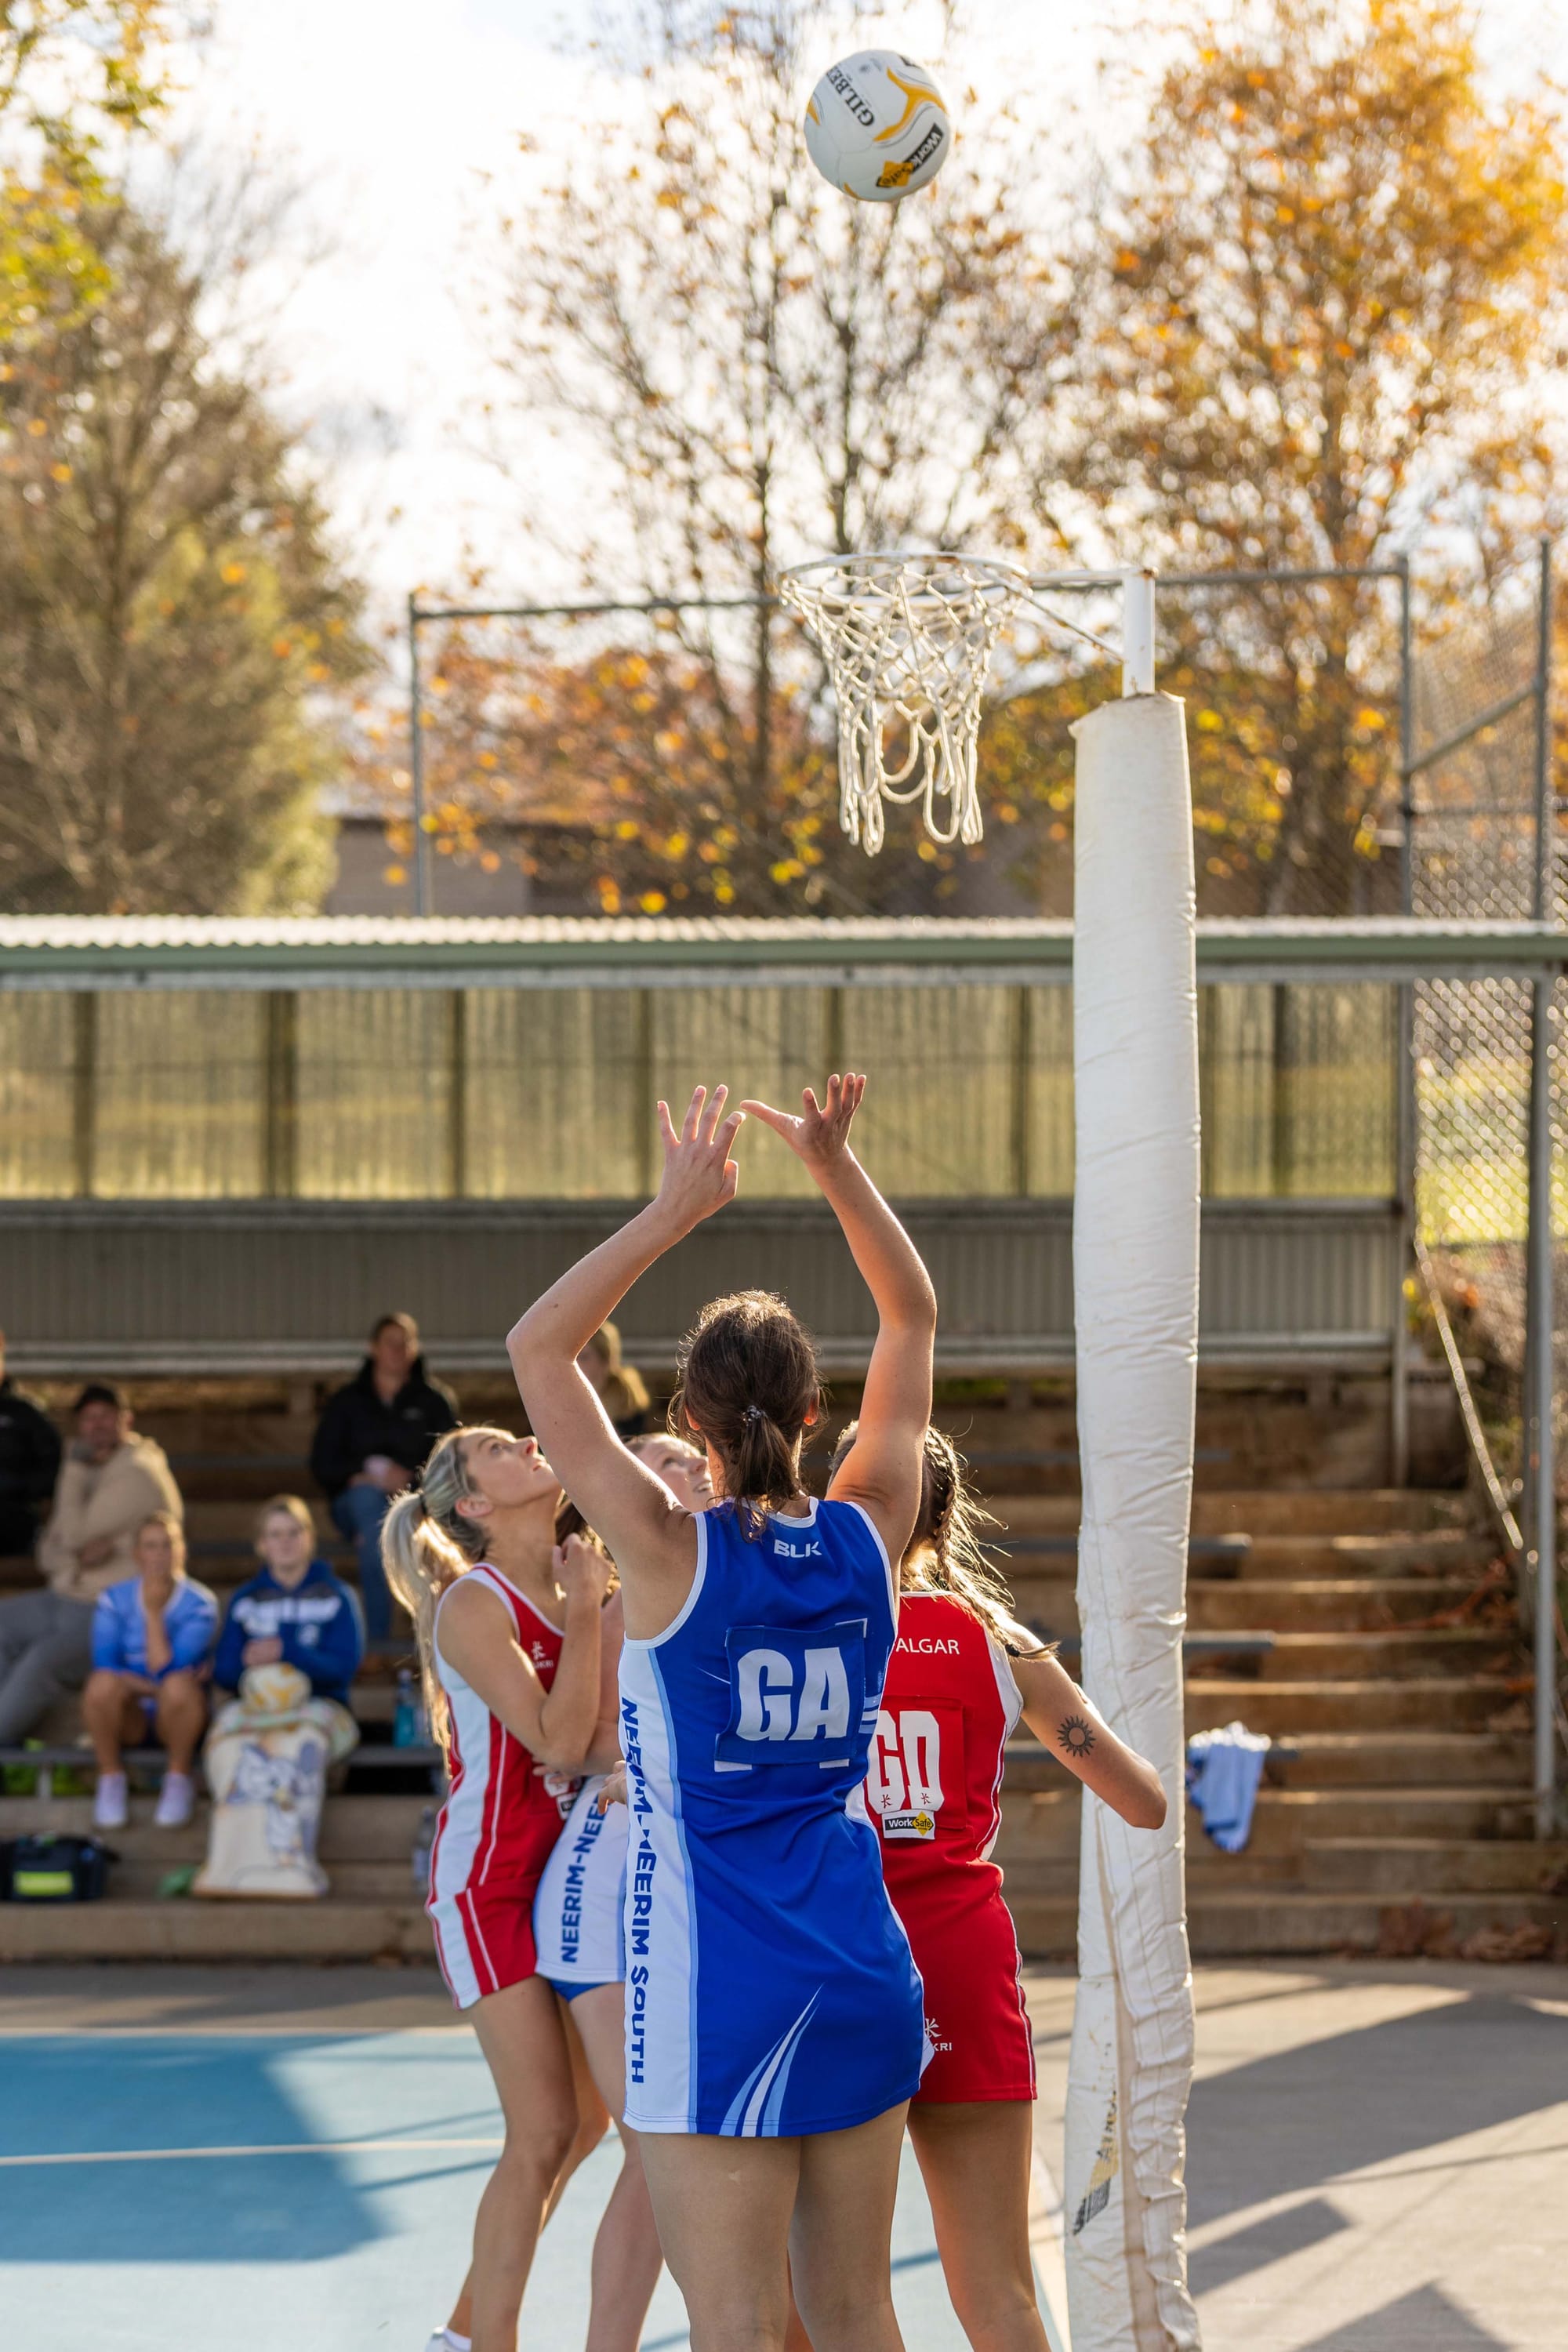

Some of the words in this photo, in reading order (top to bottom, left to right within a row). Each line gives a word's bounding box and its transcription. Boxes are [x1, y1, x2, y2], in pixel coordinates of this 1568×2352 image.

[826, 66, 875, 126] GILBE
[773, 1539, 822, 1559] BLK
[895, 1637, 960, 1655] ALGAR
[735, 1646, 851, 1741] GA
[865, 1709, 946, 1815] GD
[560, 1792, 608, 1963] NEERIM-NEE
[630, 1965, 649, 2084] SOUTH
[932, 2042, 953, 2052] KRI
